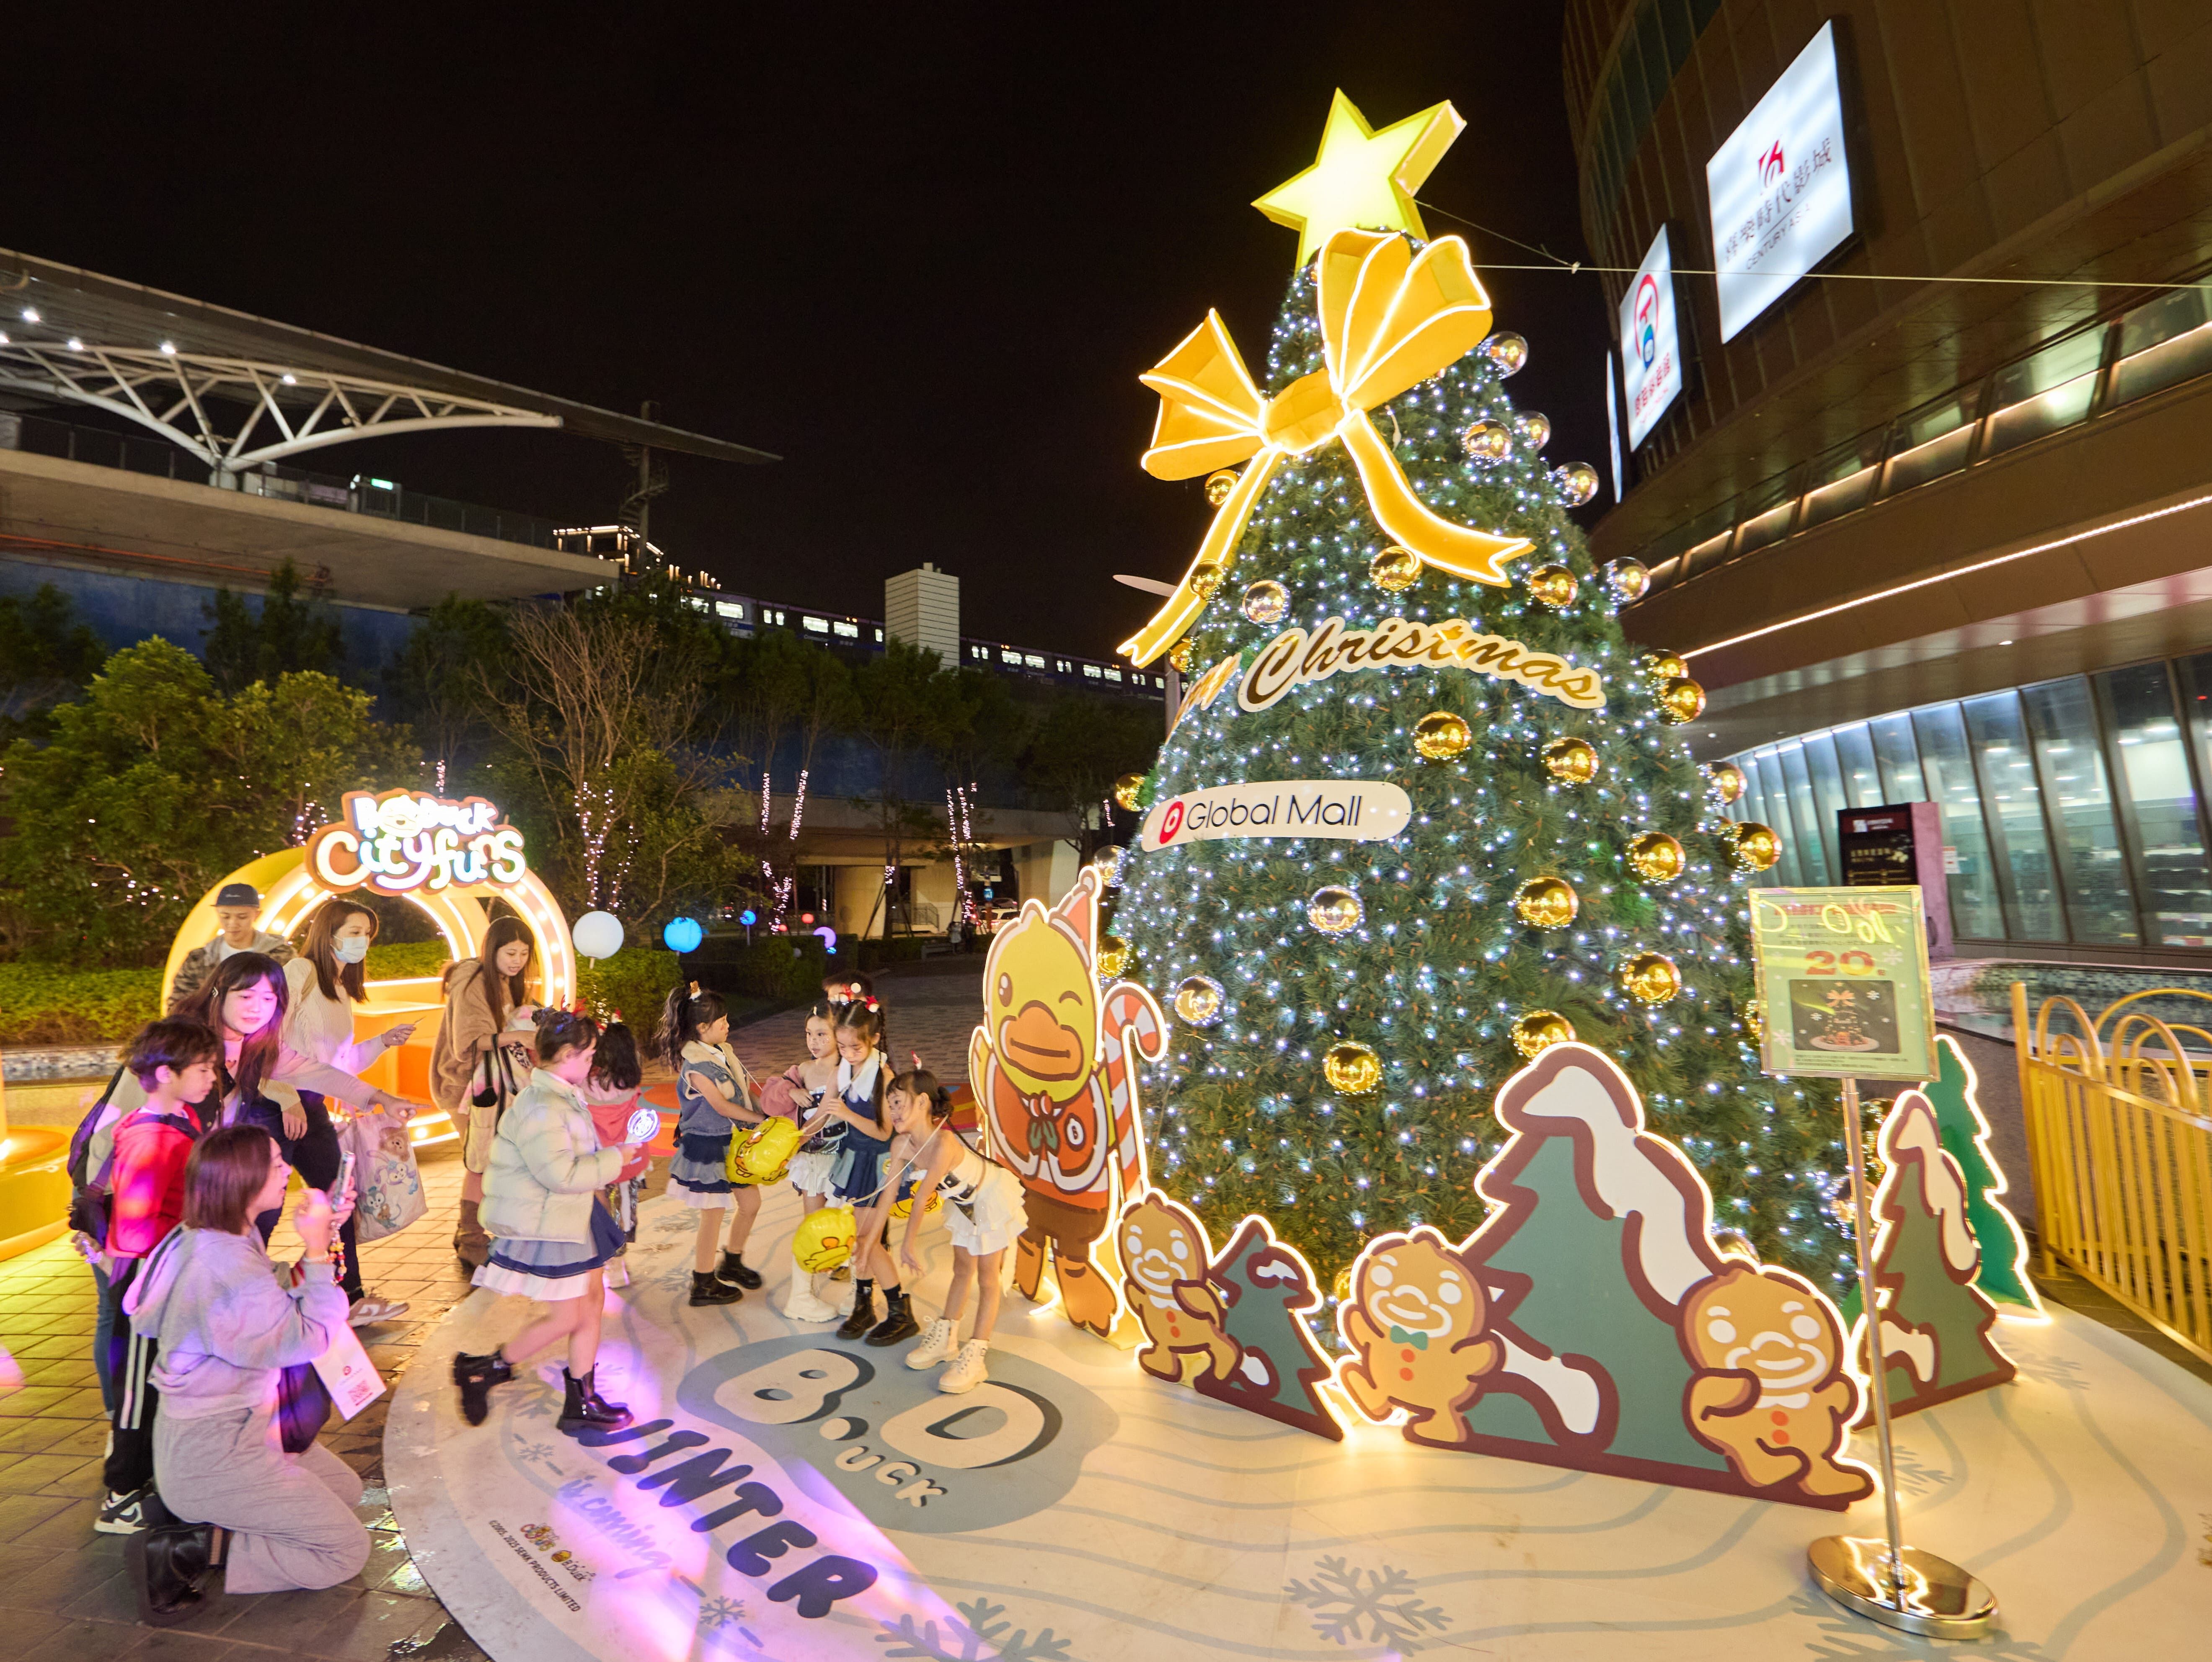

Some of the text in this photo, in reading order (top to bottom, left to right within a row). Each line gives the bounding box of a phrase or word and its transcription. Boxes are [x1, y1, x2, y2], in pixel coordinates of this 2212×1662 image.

[1746, 203, 1811, 270] CENTURY ASA
[1246, 623, 1597, 703] Christmas
[1186, 795, 1362, 830] Global Mall
[1805, 950, 1875, 976] 20
[580, 1497, 673, 1579] coming
[530, 1560, 560, 1590] PRODUCTS
[553, 1586, 581, 1612] LIMITED
